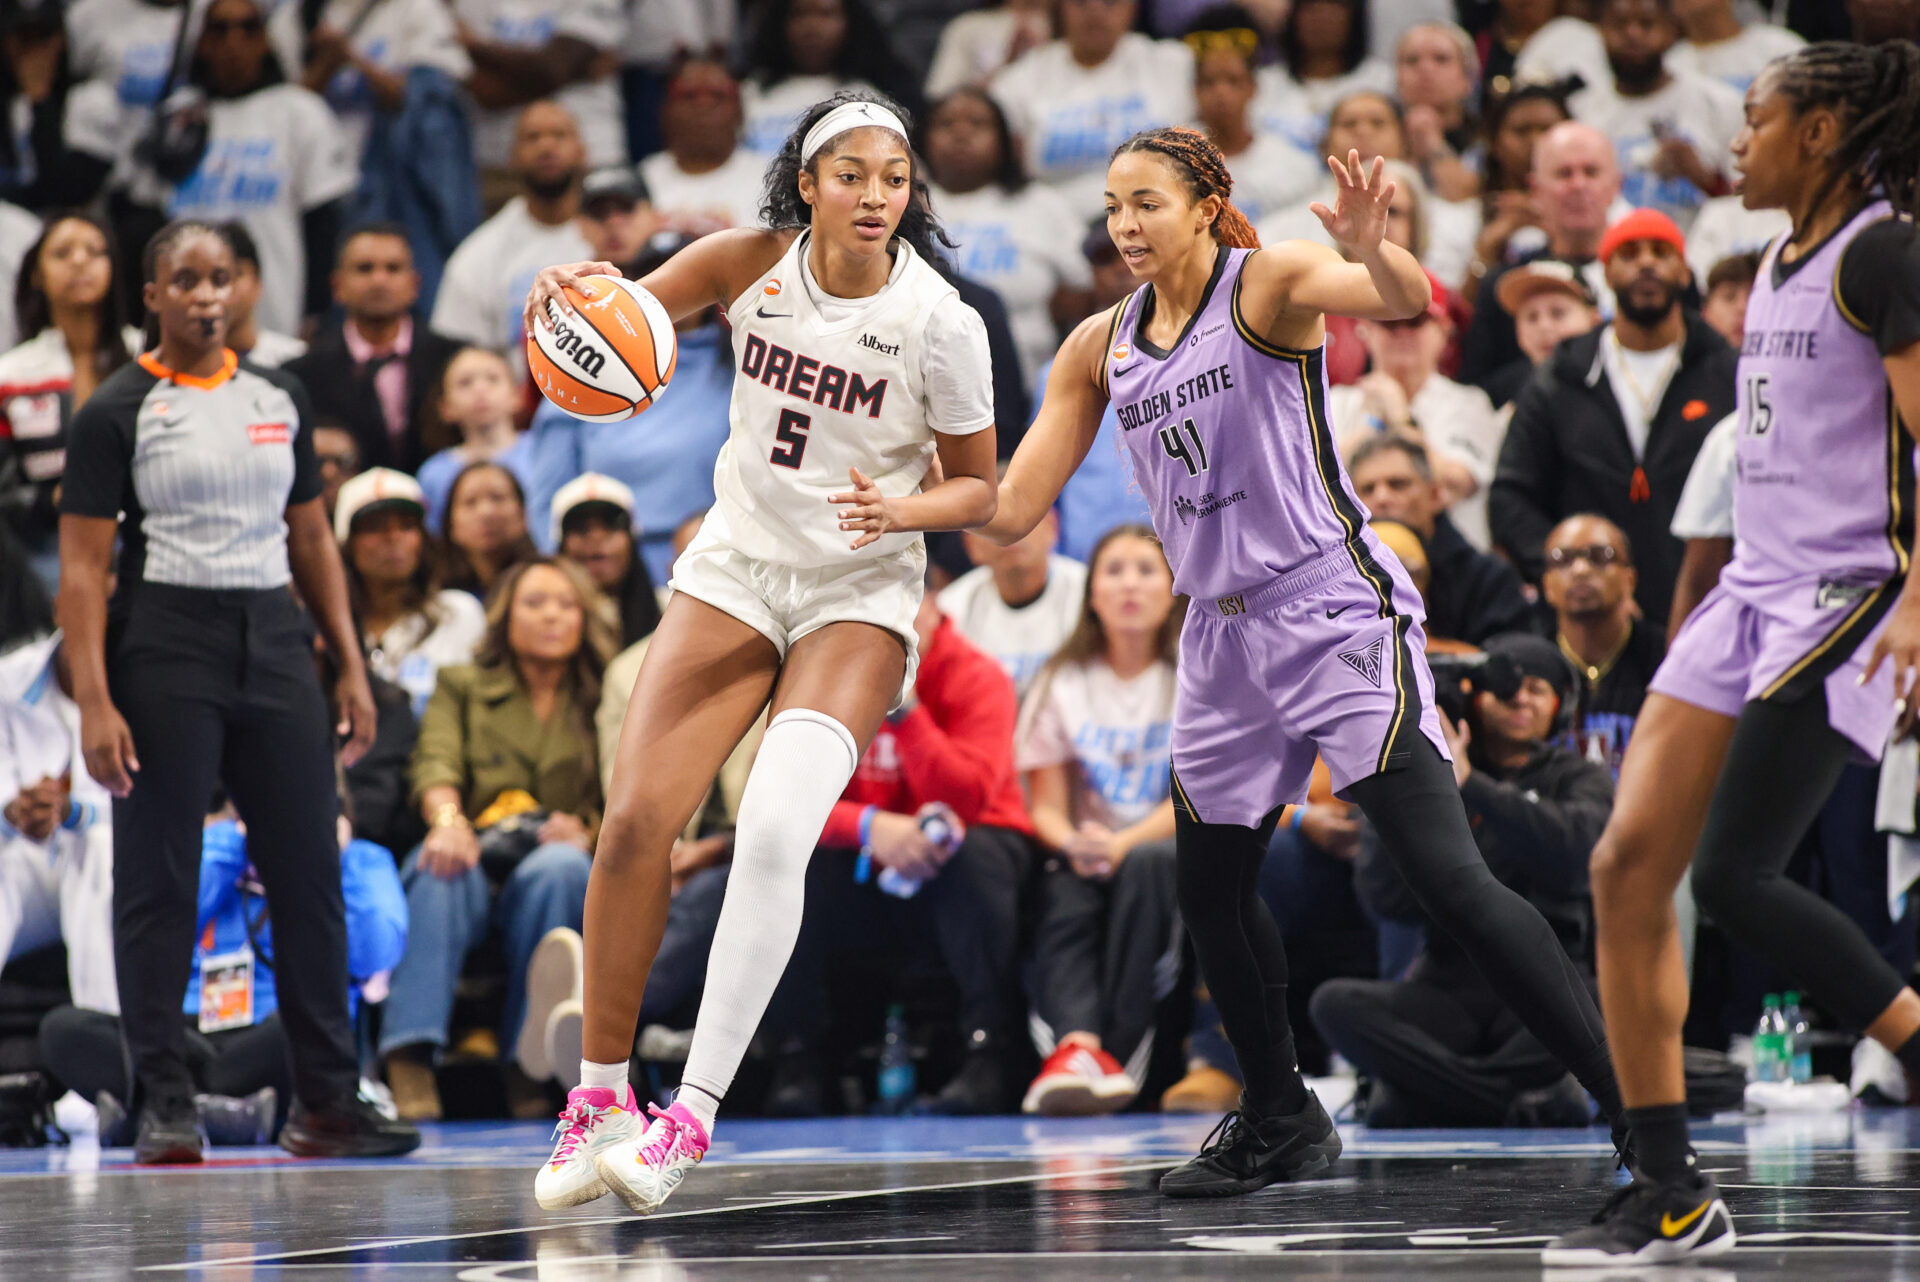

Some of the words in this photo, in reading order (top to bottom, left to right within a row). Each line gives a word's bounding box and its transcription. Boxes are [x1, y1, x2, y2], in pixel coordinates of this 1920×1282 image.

[857, 332, 900, 357] Albert
[1200, 323, 1225, 341] freedom
[1766, 330, 1818, 359] STATE
[741, 332, 889, 419] DREAM
[1116, 389, 1172, 432] GOLDEN
[1176, 363, 1234, 409] STATE
[1745, 373, 1775, 439] 15
[770, 407, 812, 470] 5
[1158, 416, 1209, 478] 41
[1196, 490, 1248, 519] ERMAENTE
[1197, 492, 1215, 506] SER
[1217, 594, 1246, 616] GSV
